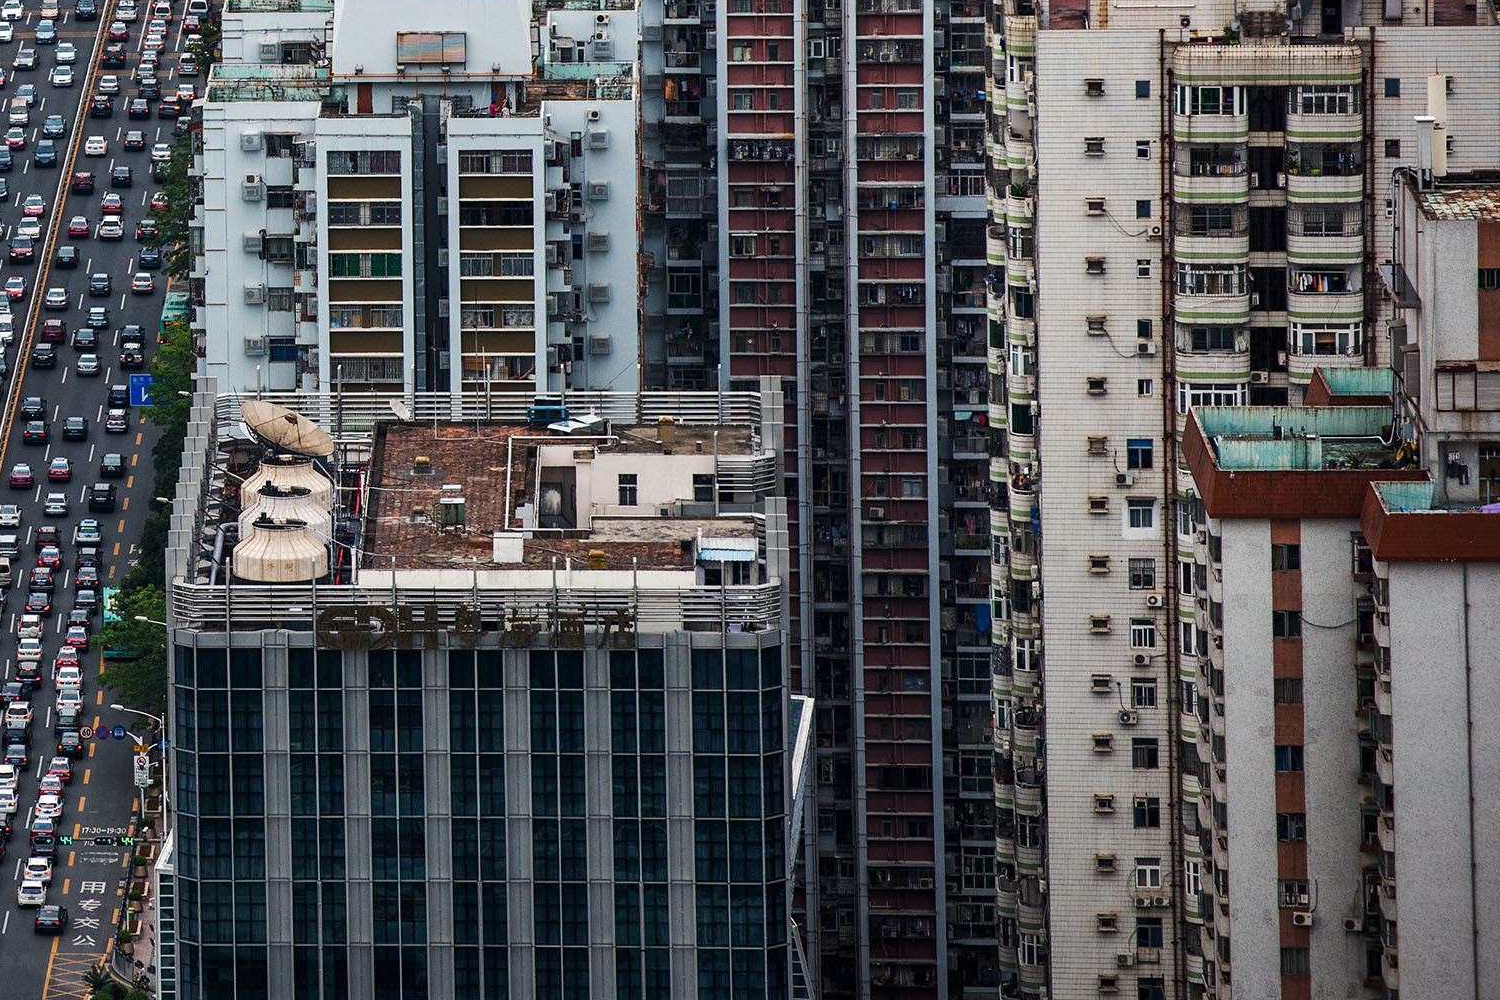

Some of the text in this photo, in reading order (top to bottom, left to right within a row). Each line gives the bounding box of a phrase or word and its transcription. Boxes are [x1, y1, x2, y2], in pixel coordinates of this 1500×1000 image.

[316, 604, 634, 650] GDH 粤海酒店
[82, 729, 91, 737] 60
[81, 826, 127, 834] 17:30-19:30
[59, 836, 73, 845] 44
[121, 836, 134, 846] 44
